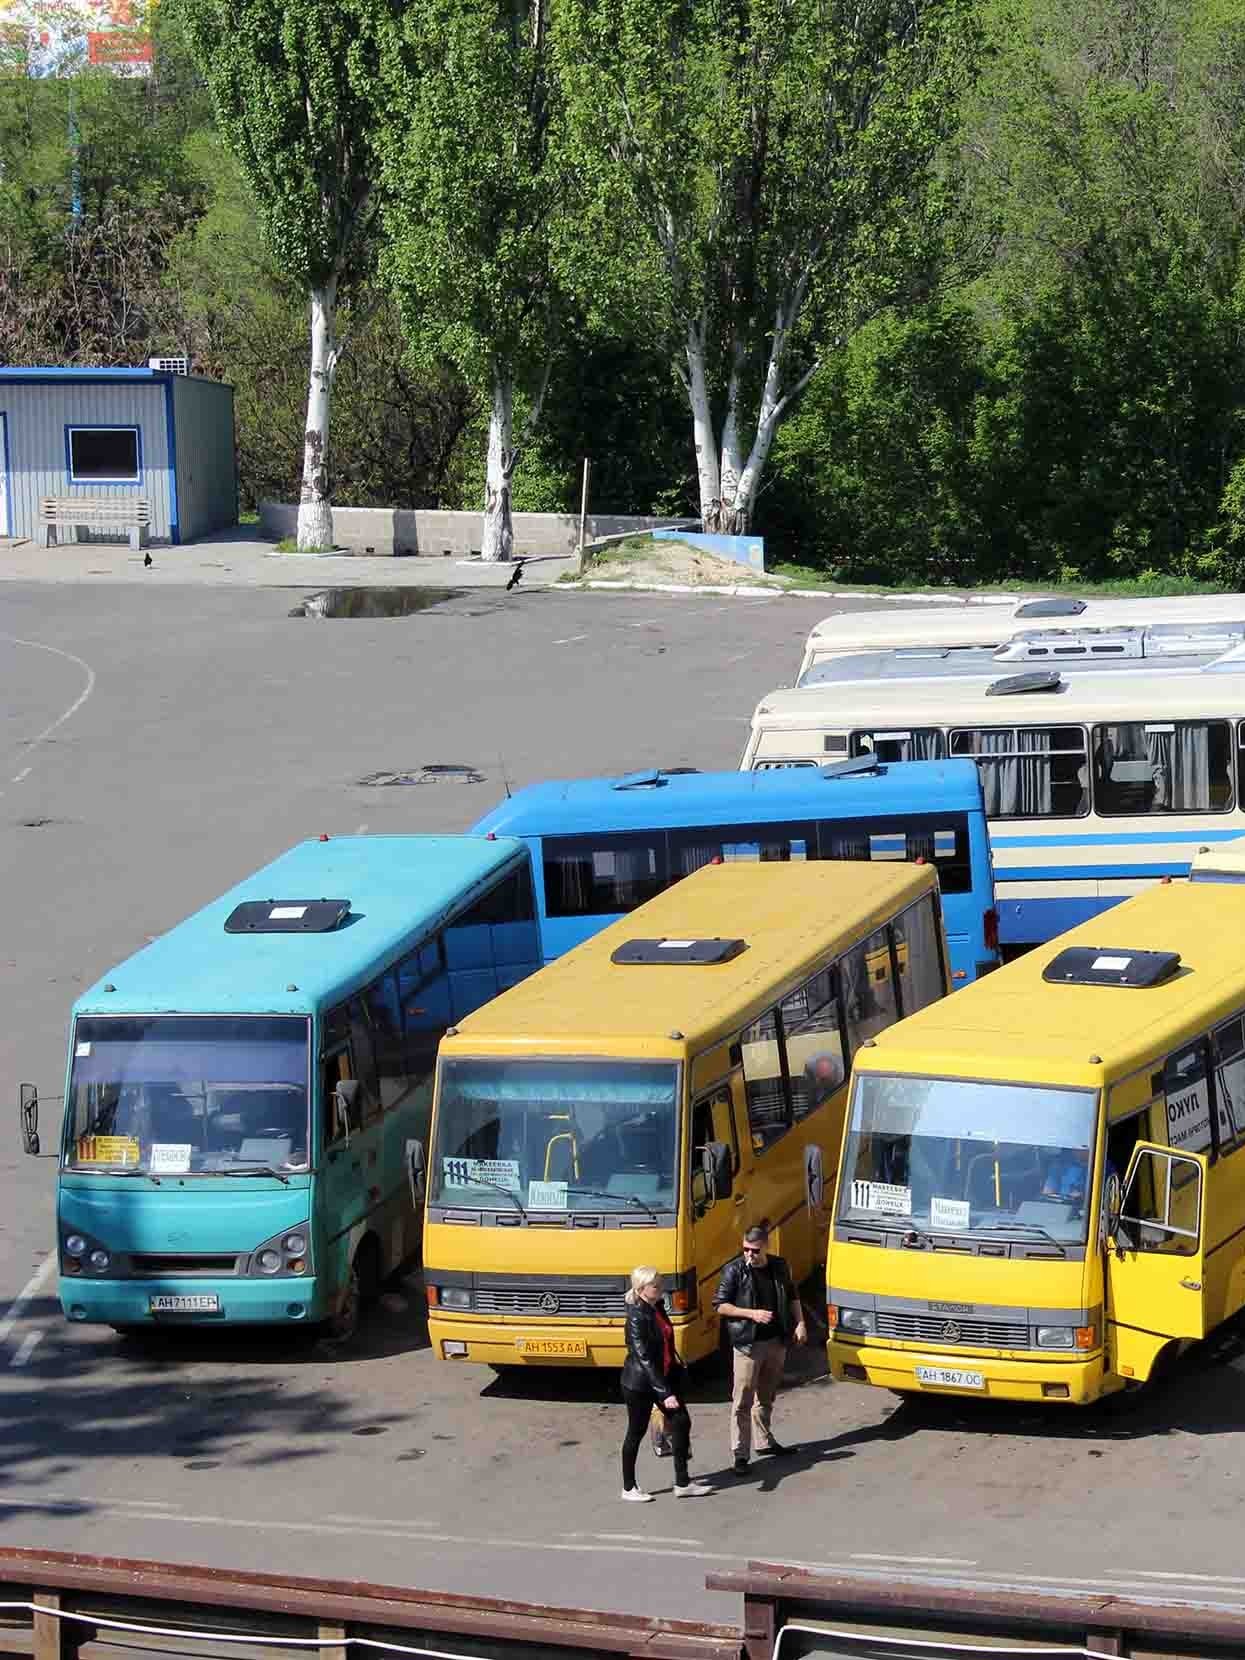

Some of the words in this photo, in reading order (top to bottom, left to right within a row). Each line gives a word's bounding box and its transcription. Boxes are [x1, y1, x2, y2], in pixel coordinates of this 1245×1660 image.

[447, 1160, 470, 1185] 111
[855, 1182, 870, 1208] 111
[526, 1343, 539, 1352] AH
[543, 1342, 565, 1352] 1553
[922, 1369, 937, 1380] AH
[941, 1372, 962, 1383] 1867
